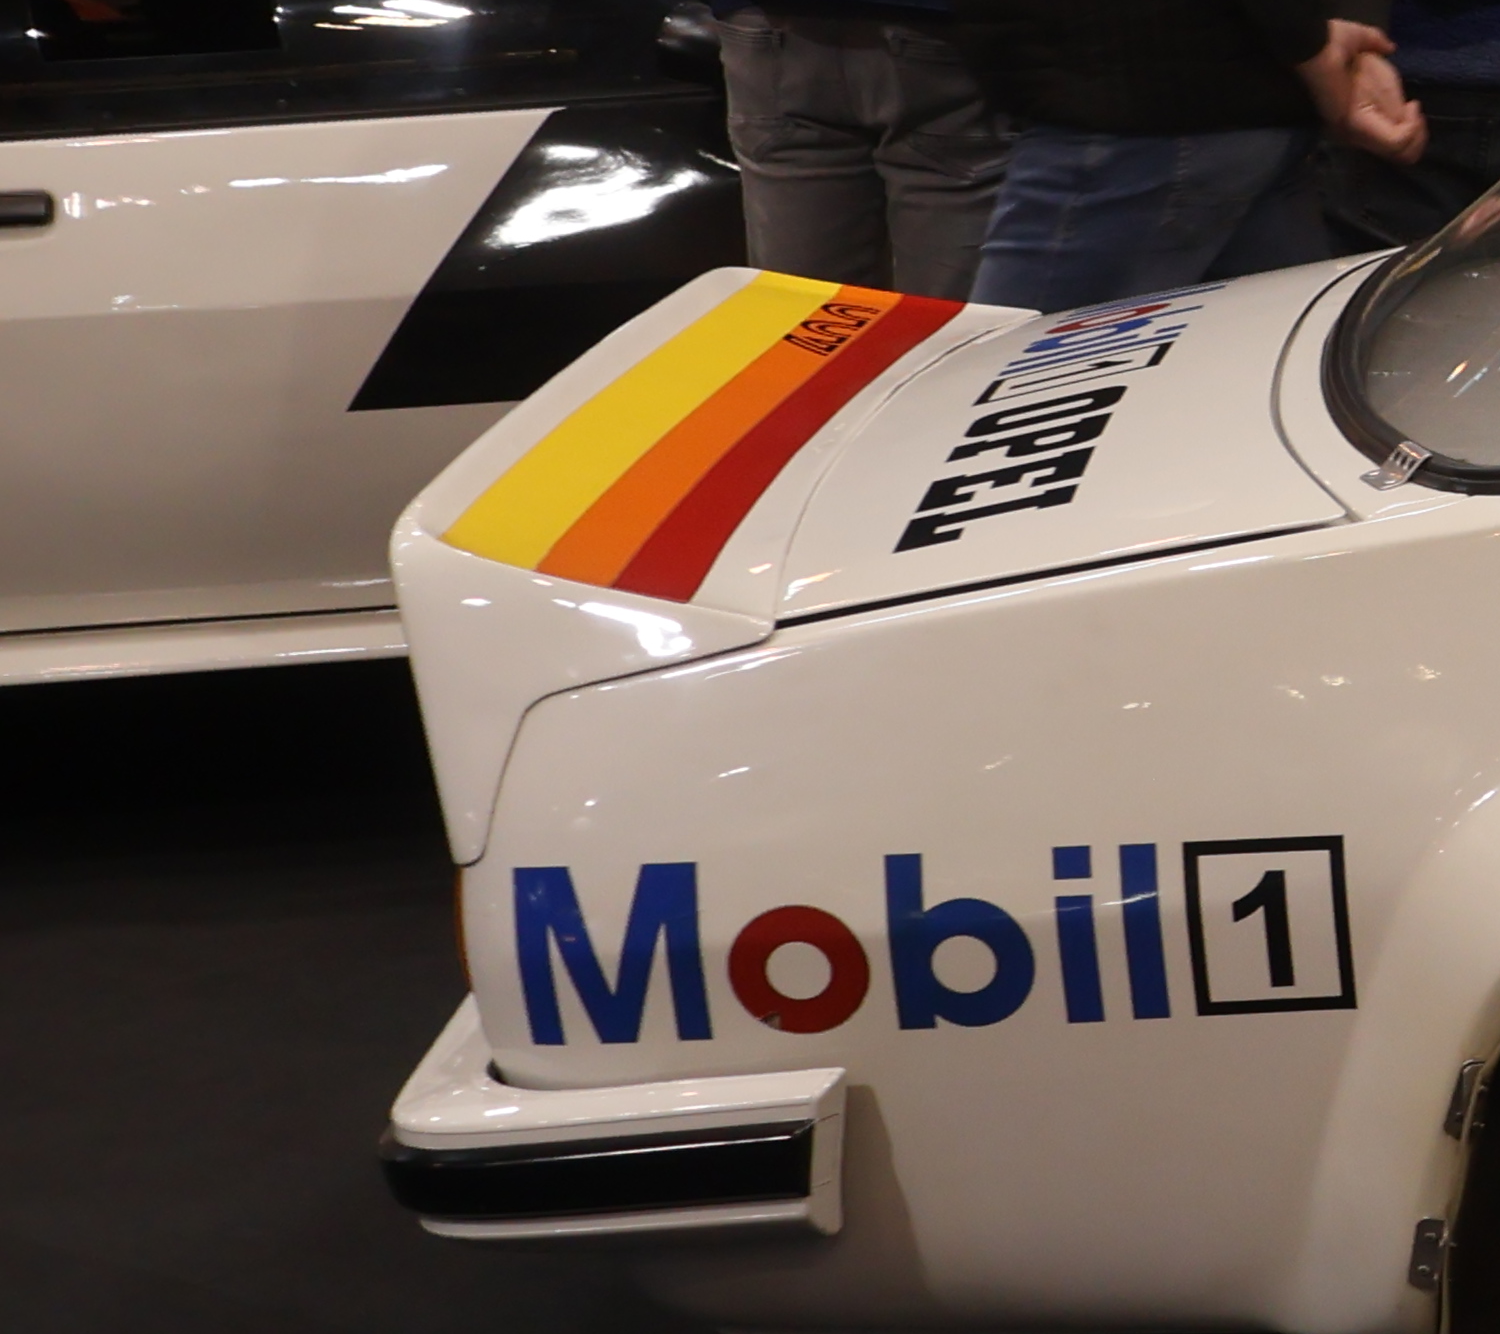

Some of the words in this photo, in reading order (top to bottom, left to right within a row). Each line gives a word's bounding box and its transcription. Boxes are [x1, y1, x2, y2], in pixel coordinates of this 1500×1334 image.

[782, 302, 881, 357] 400
[892, 384, 1129, 555] OPEL
[512, 842, 1172, 1047] Mobil
[1230, 868, 1297, 989] 1
